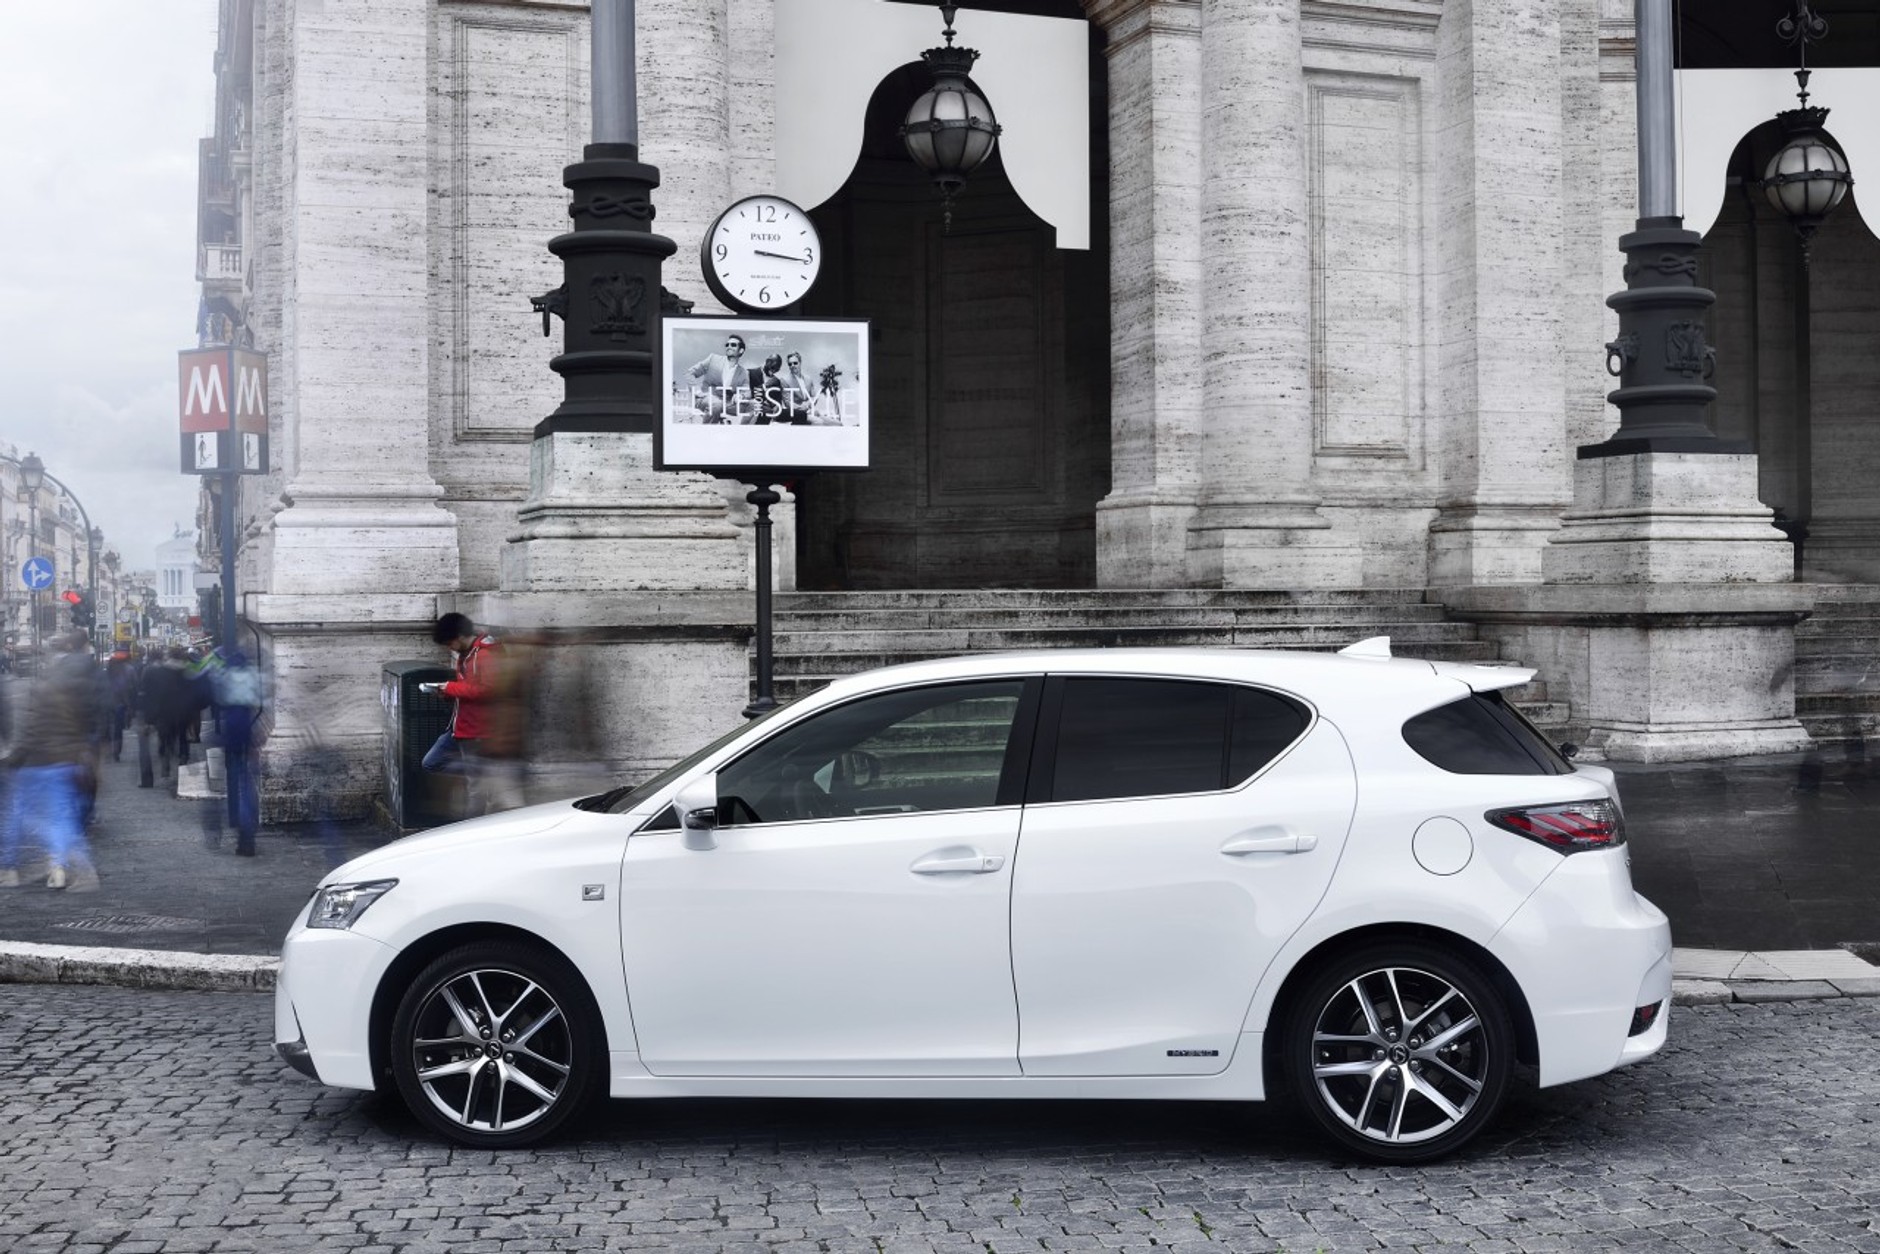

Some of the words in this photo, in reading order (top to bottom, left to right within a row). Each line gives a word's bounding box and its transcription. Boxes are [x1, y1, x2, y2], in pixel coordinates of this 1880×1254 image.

[756, 205, 776, 223] 12
[716, 243, 728, 262] 9
[803, 247, 813, 265] 3
[759, 286, 771, 304] 6
[185, 364, 227, 415] M
[236, 367, 264, 415] M
